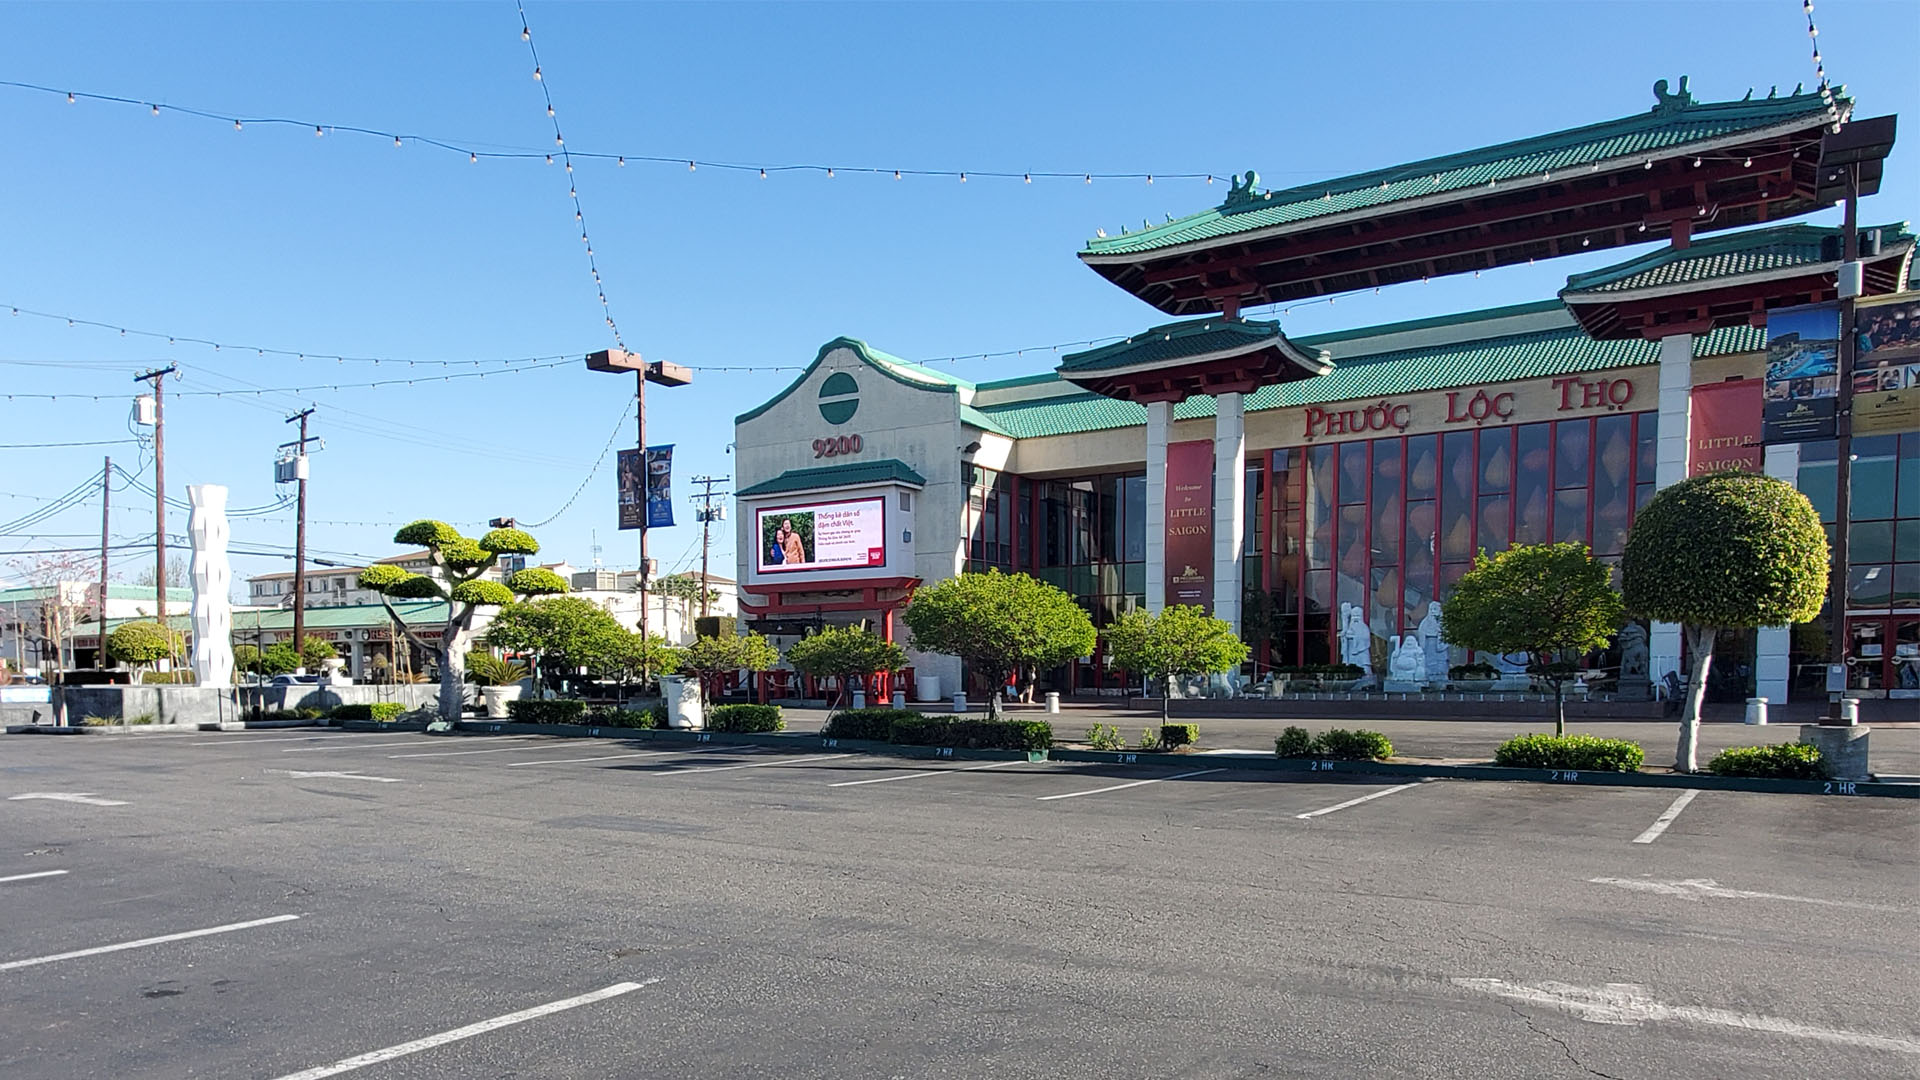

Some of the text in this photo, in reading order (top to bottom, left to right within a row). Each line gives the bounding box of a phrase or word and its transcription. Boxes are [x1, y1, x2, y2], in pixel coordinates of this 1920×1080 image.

[1552, 377, 1633, 411] THỌ
[812, 433, 864, 459] 9200
[1698, 435, 1753, 450] LITTLE
[1696, 457, 1753, 472] SAIGON
[1170, 507, 1206, 518] LITTLE
[1168, 525, 1207, 536] SAIGON
[935, 747, 953, 756] 2 HR
[1117, 754, 1137, 764] 2 HR
[1311, 760, 1334, 771] 2 HR
[1551, 770, 1578, 782] 2 HR
[1823, 782, 1856, 795] 2 HR
